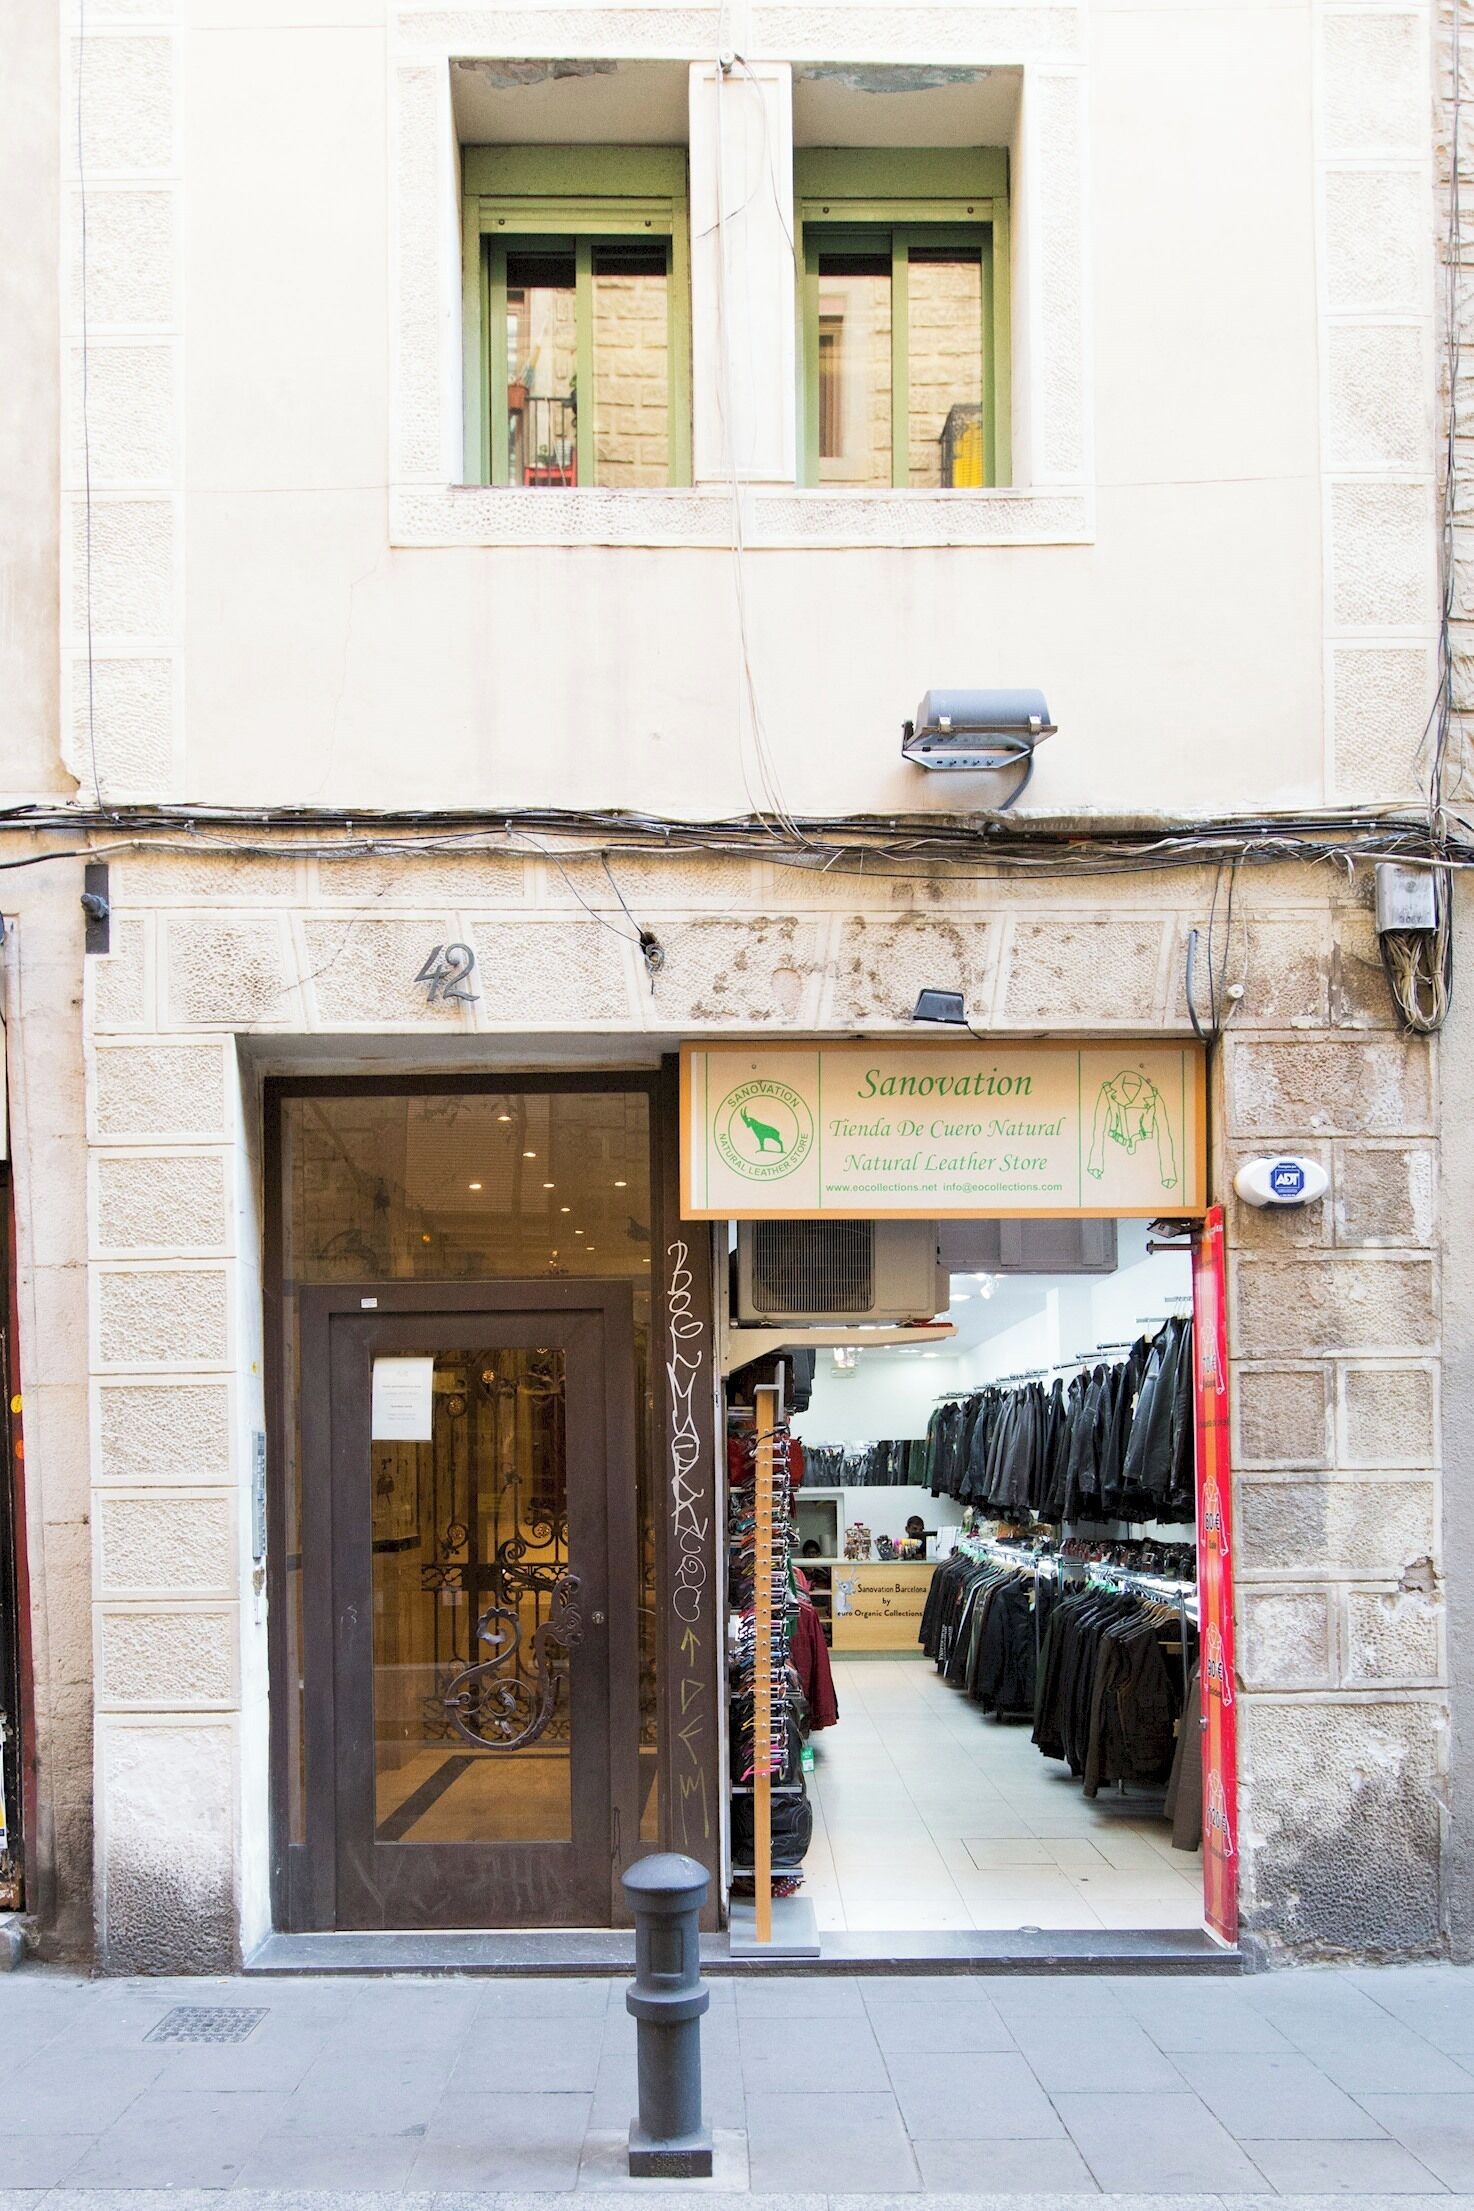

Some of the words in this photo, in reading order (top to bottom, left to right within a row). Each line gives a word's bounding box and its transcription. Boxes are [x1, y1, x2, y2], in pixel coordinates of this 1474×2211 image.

[413, 943, 480, 1001] 42
[857, 1067, 1033, 1099] Sanovation
[727, 1084, 801, 1108] SANOVATION
[829, 1117, 891, 1137] Tienda
[896, 1119, 924, 1137] De
[930, 1119, 982, 1138] Cuero
[986, 1117, 1067, 1137] Natural
[719, 1133, 748, 1171] NATURAL
[748, 1160, 791, 1176] LEATHER
[790, 1132, 809, 1164] STORE
[843, 1151, 923, 1173] Natural
[924, 1151, 996, 1172] Leather
[999, 1153, 1048, 1172] Store
[825, 1182, 938, 1192] www.eocollections.net
[943, 1182, 1063, 1193] info@eocollections.com
[1275, 1172, 1300, 1186] ADT
[857, 1583, 894, 1593] Sanovation
[895, 1583, 927, 1593] Barcelona
[882, 1597, 892, 1607] by
[854, 1609, 882, 1619] Organic
[883, 1609, 923, 1617] Collections
